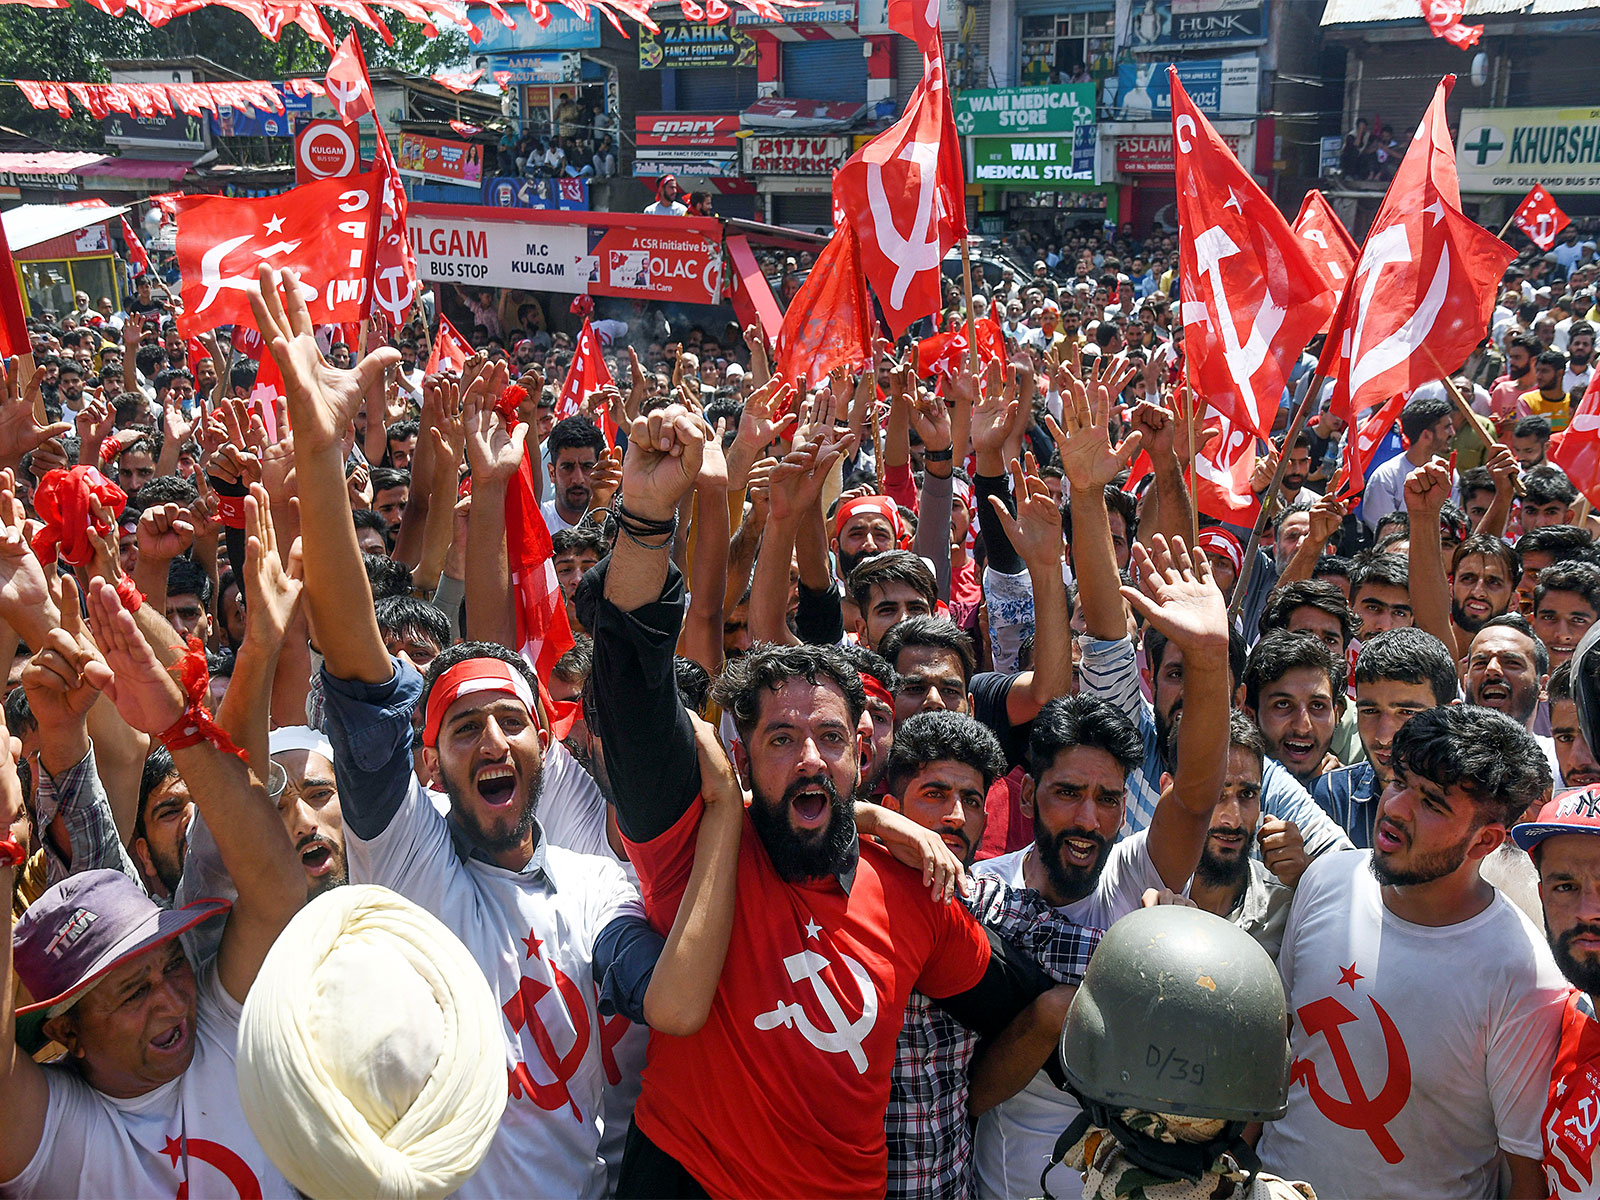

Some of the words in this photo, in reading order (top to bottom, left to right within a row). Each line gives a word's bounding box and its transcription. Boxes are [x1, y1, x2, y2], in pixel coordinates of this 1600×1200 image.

[774, 9, 852, 24] NTERPRISES
[1180, 14, 1254, 34] HUNK
[664, 25, 728, 43] ZAHIK
[1178, 31, 1202, 39] GYM
[1205, 29, 1232, 38] VEST
[664, 45, 689, 56] FANCY
[692, 44, 734, 56] FOOTWEAR
[969, 95, 1009, 112] WANI
[1012, 92, 1079, 110] MEDICAL
[999, 109, 1047, 126] STORE
[311, 146, 344, 155] KULGAM
[759, 139, 826, 155] BITTU
[1011, 143, 1057, 161] WANI
[1119, 137, 1172, 153] ASLAM
[16, 173, 78, 185] COLLECTION
[976, 165, 1040, 179] MEDICAL
[1492, 177, 1515, 186] OPP.
[1518, 177, 1537, 185] OLD
[1565, 177, 1585, 186] BUS
[384, 226, 488, 259] LGAM
[527, 244, 549, 257] M.C
[632, 238, 639, 248] A
[641, 238, 658, 249] CSR
[660, 238, 700, 252] initiative
[431, 261, 454, 277] BUS
[457, 263, 488, 280] STOP
[511, 261, 565, 277] KULGAM
[650, 257, 698, 279] OLAC
[657, 283, 673, 292] Care
[1145, 1044, 1205, 1086] D/39
